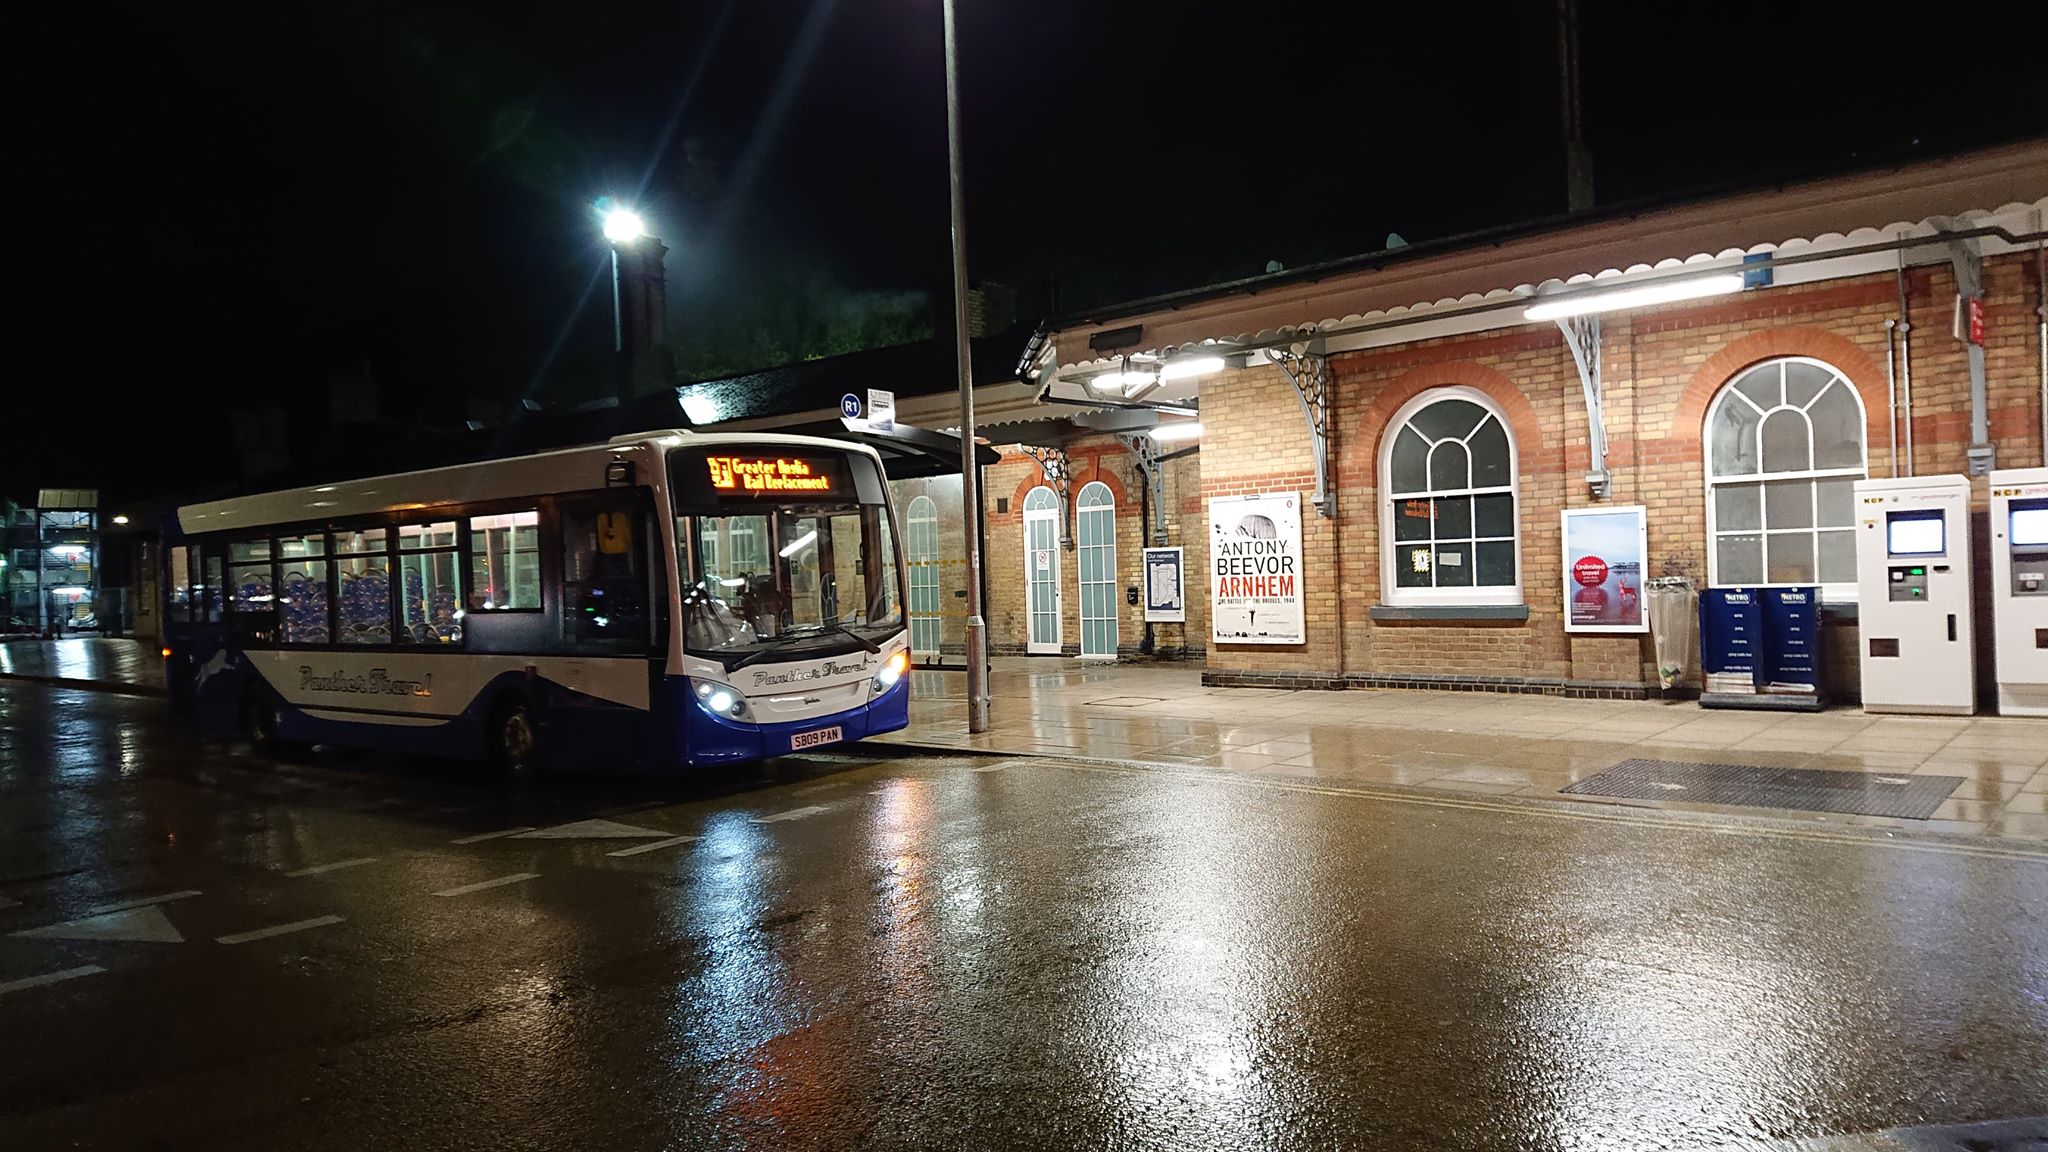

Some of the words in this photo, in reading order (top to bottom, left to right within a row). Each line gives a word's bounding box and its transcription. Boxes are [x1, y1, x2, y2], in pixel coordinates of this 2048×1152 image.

[844, 400, 858, 413] R1
[732, 459, 776, 474] Greater
[743, 474, 765, 489] Rail
[764, 475, 830, 490] Replacement
[1221, 540, 1287, 556] ANTONY
[1217, 556, 1294, 575] BEEVOR
[1219, 576, 1294, 597] ARNHEM
[299, 665, 367, 693] Panther
[368, 668, 432, 697] Travel
[753, 669, 821, 687] Panther
[821, 659, 868, 677] Travel
[794, 732, 819, 748] SB09
[820, 728, 838, 743] PAN
